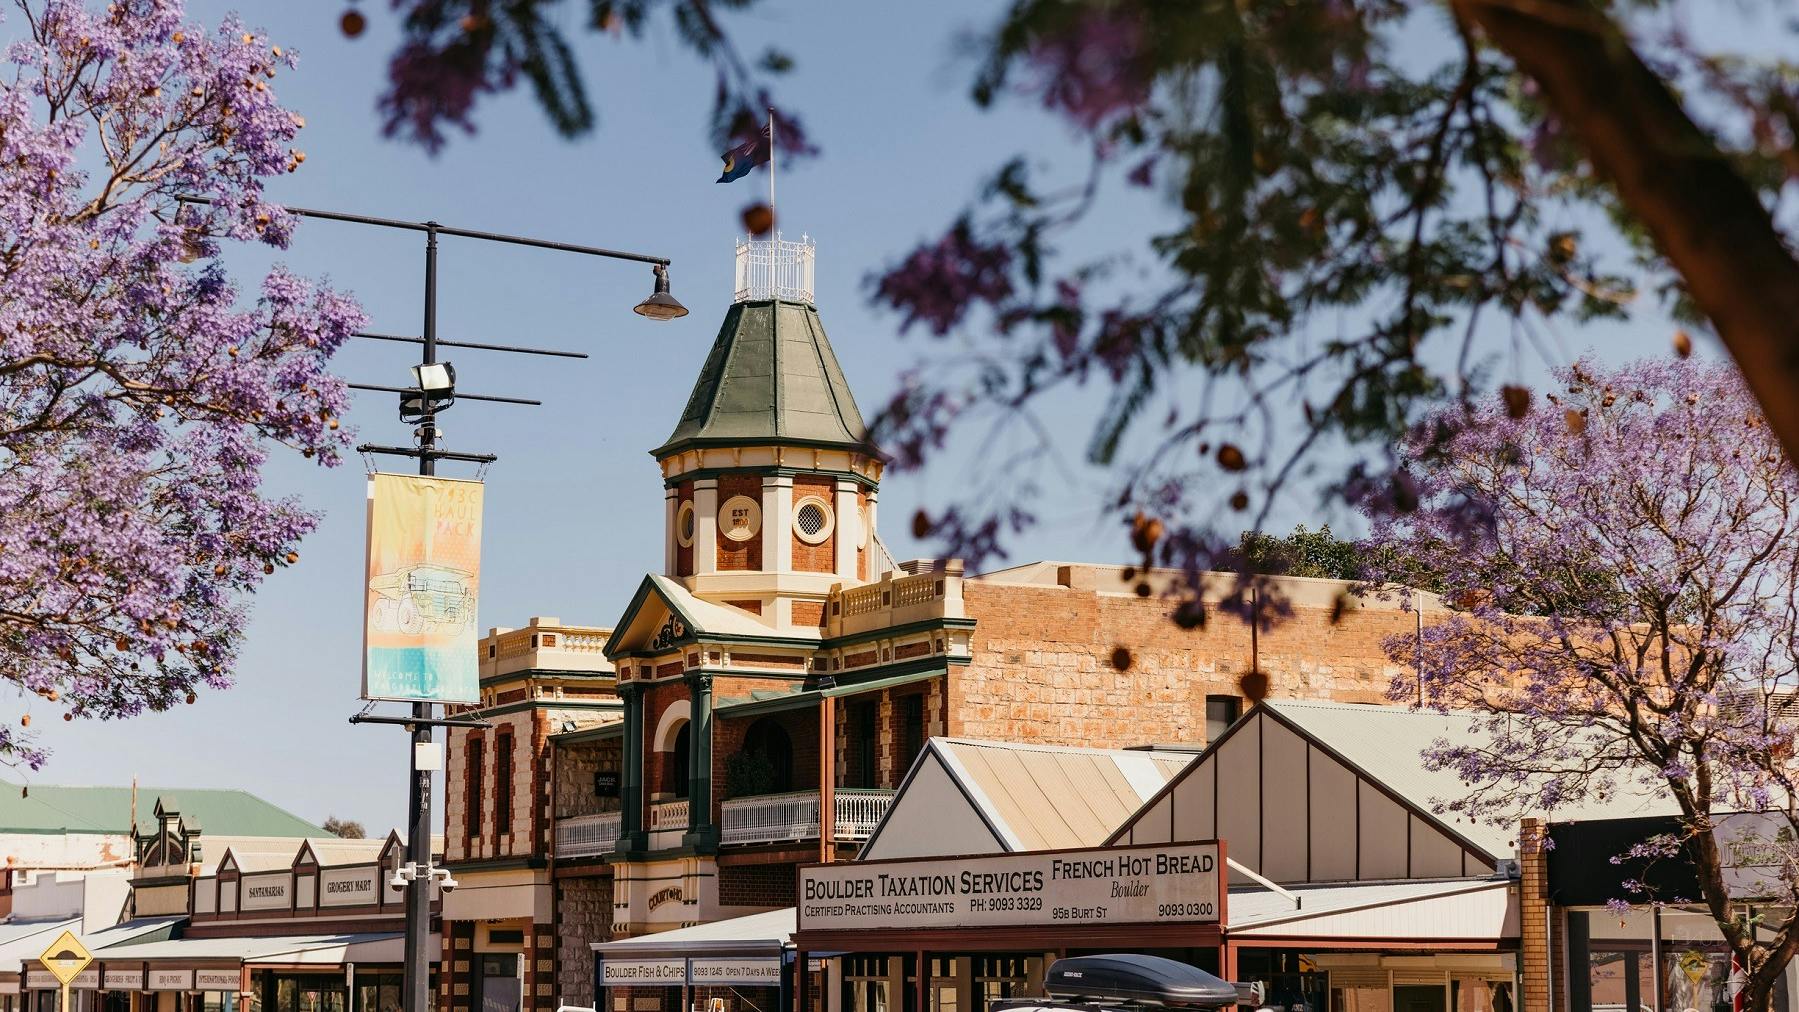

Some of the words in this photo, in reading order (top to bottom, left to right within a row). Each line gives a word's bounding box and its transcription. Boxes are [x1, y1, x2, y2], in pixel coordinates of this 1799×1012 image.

[732, 508, 749, 517] EST
[1052, 859, 1114, 880] FRENCH
[1118, 855, 1151, 876] HOT
[1156, 853, 1214, 875] BREAD
[355, 880, 371, 892] MART
[805, 878, 874, 900] BOULDER
[878, 873, 955, 897] TAXATION
[960, 870, 1043, 894] SERVICES
[1110, 880, 1149, 898] Boulder
[649, 888, 669, 910] COURT
[804, 905, 843, 917] CERTIFIED
[845, 903, 891, 916] PRACTISING
[893, 901, 954, 915] ACCOUNTANTS
[970, 898, 987, 912] PH:
[988, 897, 1014, 912] 9093
[1016, 897, 1042, 911] 3329
[1071, 907, 1095, 919] BURT
[1096, 906, 1108, 918] ST
[1158, 904, 1184, 917] 9093
[1186, 903, 1213, 915] 0300
[605, 966, 637, 978] BOULDER
[638, 965, 654, 978] FISH
[655, 965, 661, 977] &
[662, 965, 685, 978] CHIPS
[725, 967, 740, 976] OPEN
[746, 967, 760, 976] DAYS
